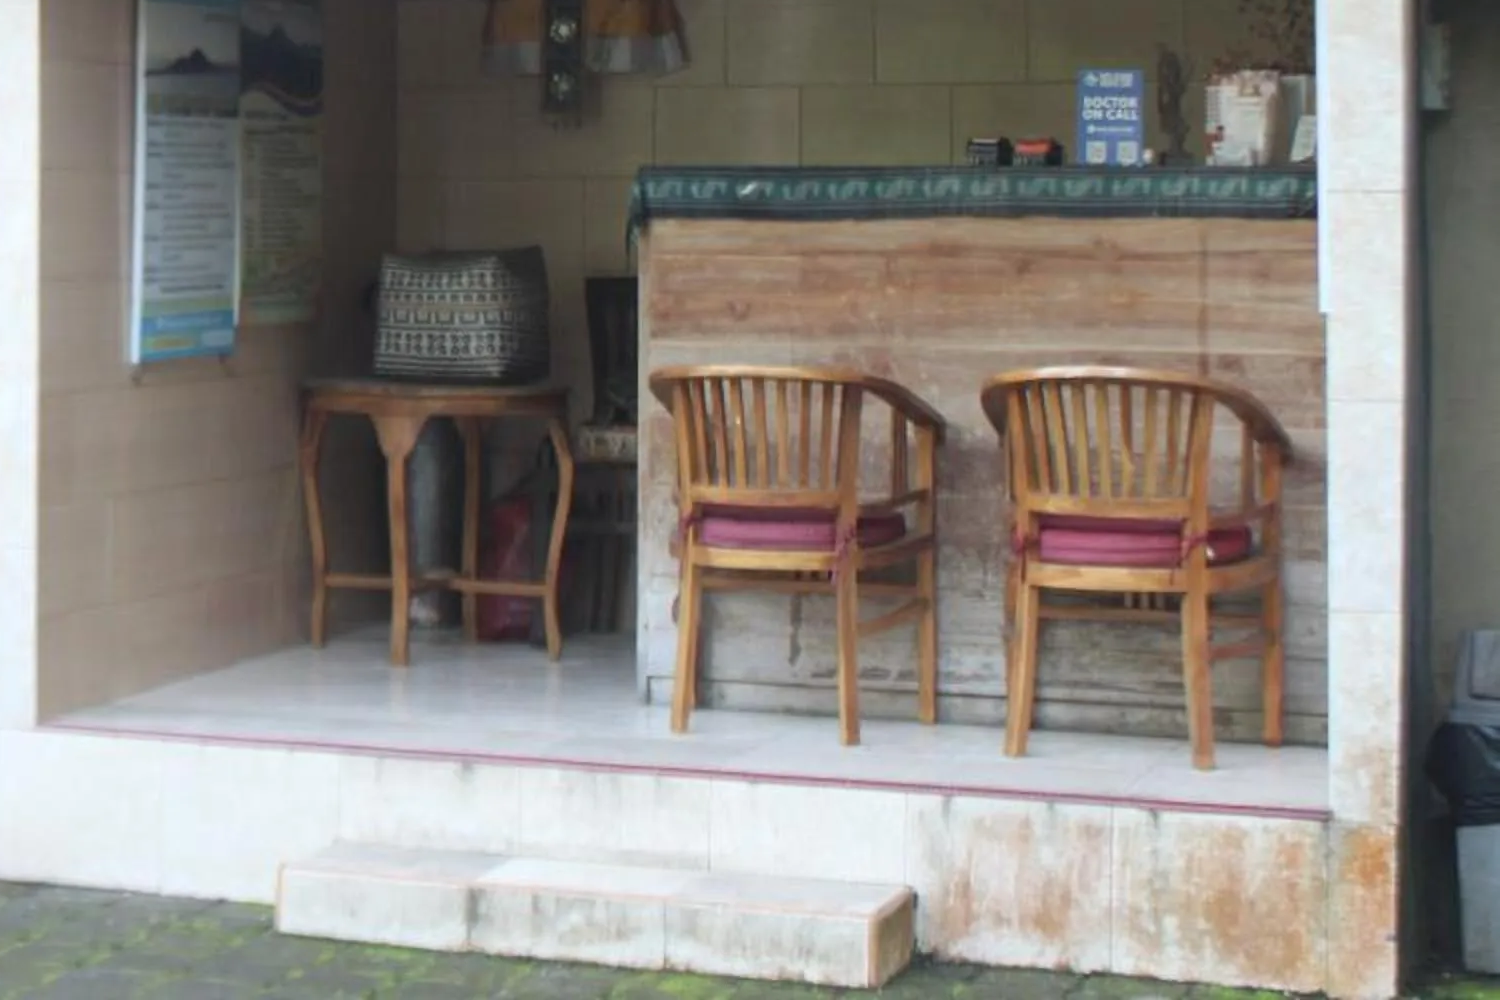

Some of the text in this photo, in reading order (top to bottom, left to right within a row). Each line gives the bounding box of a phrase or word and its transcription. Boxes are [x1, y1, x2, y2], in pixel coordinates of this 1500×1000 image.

[1083, 96, 1138, 109] DOCTOR
[1082, 109, 1138, 121] ON CALL
